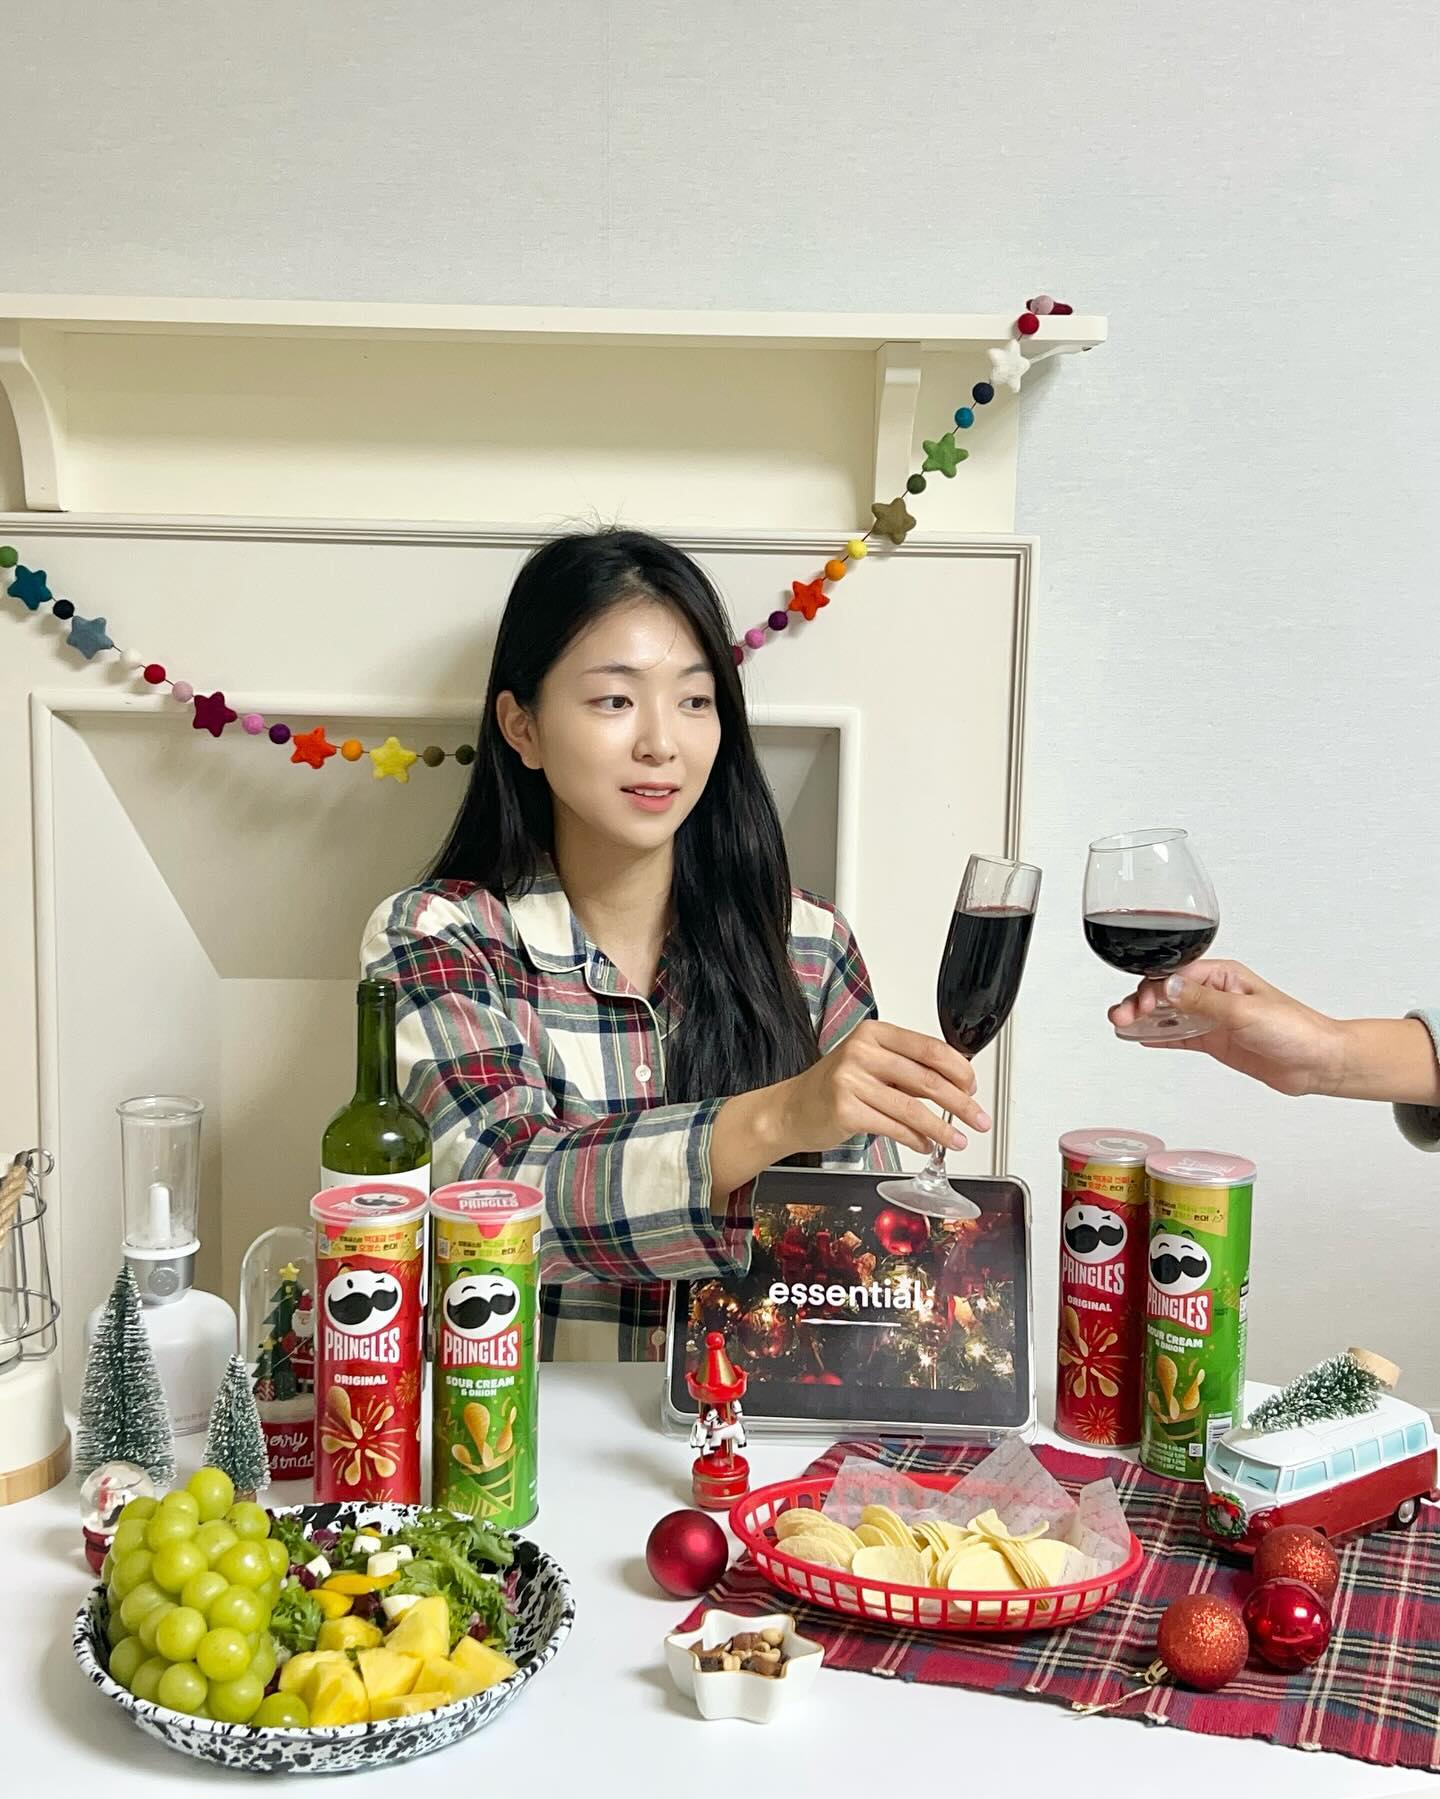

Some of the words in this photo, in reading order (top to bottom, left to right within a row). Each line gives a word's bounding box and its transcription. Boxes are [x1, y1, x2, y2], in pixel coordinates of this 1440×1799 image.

[460, 1199, 519, 1210] PRINGLES
[1062, 1252, 1126, 1296] PRINGLES
[1067, 1295, 1113, 1313] ORIGINAL
[1146, 1284, 1209, 1331] PRINGLES
[325, 1325, 400, 1364] PRINGLES
[443, 1330, 518, 1367] PRINGLES
[1160, 1342, 1186, 1354] ONION
[1166, 1331, 1204, 1349] CREAM
[334, 1373, 389, 1386] ORIGINAL
[445, 1375, 474, 1388] SOUR
[475, 1375, 516, 1389] CREAM
[468, 1388, 498, 1397] ONION
[264, 1432, 308, 1453] erry
